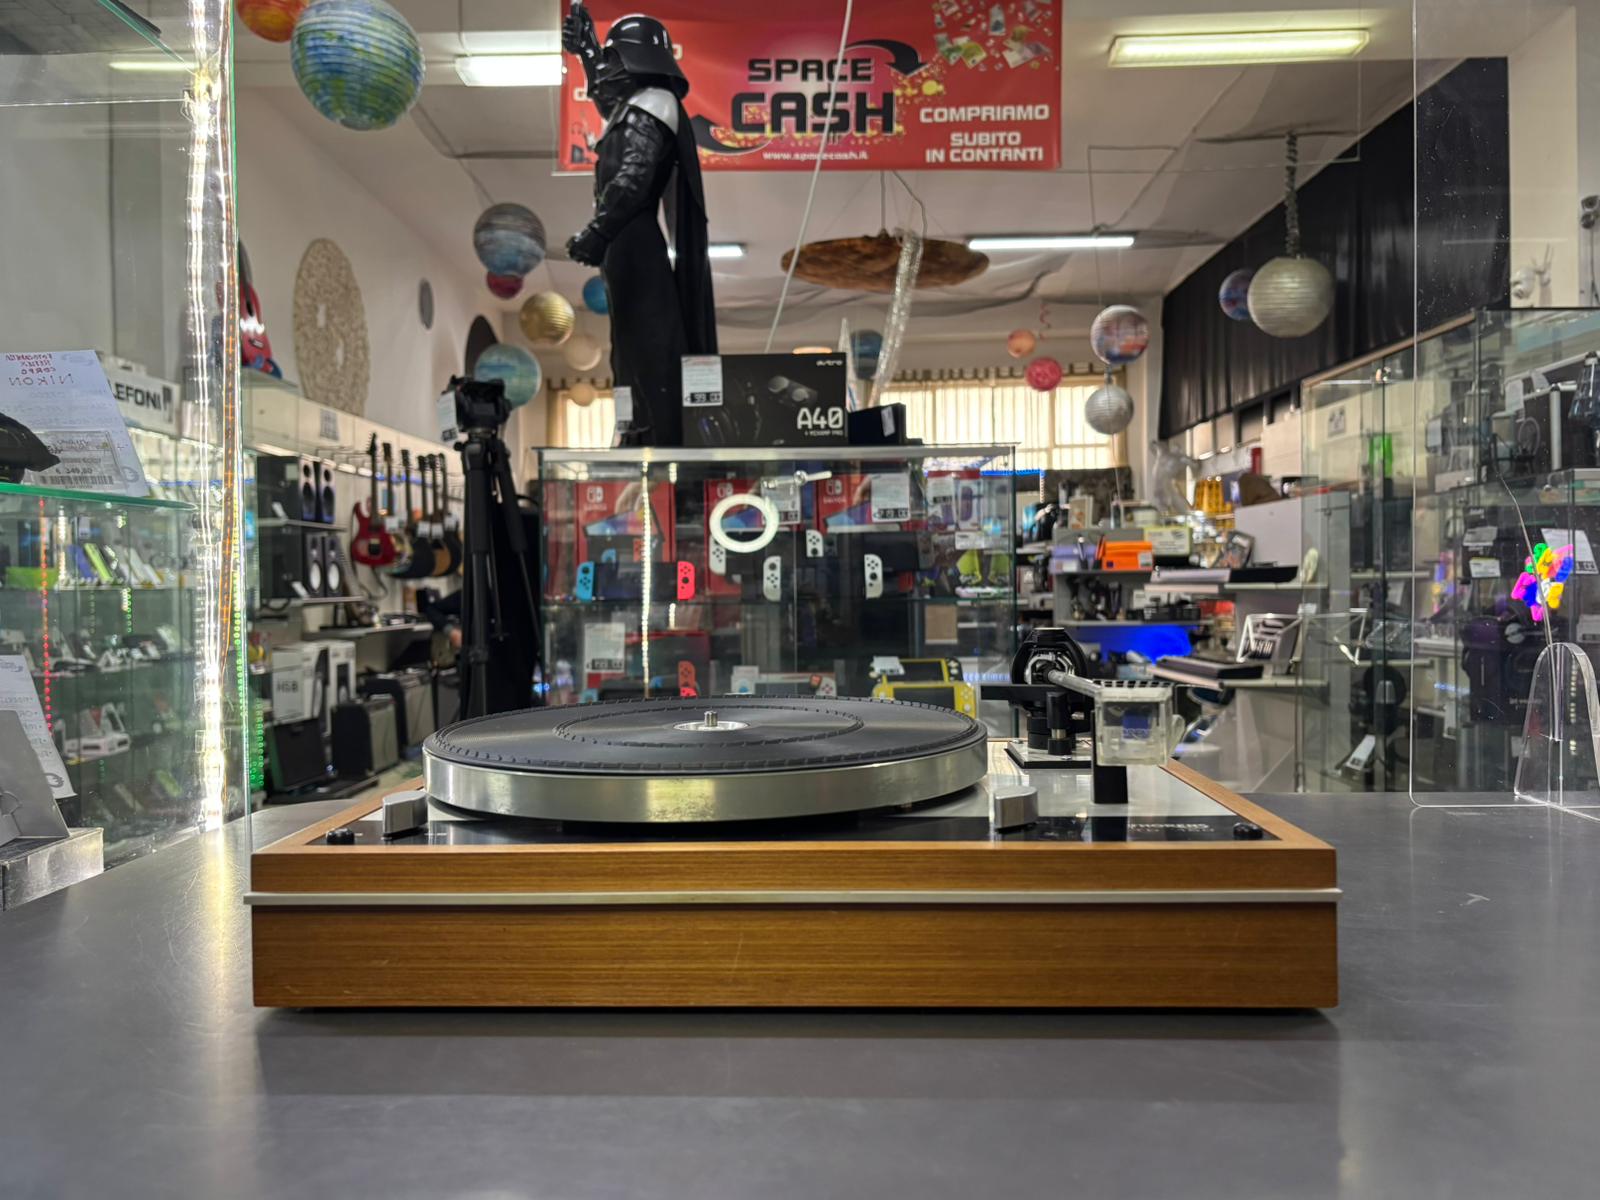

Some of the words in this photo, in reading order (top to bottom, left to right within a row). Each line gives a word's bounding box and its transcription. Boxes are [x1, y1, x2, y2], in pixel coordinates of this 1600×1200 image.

[747, 58, 872, 82] SPACE
[731, 92, 895, 134] CASH
[919, 104, 1050, 123] COMPRIAMO
[950, 131, 1021, 147] SUBITO
[925, 148, 945, 163] IN
[949, 146, 1044, 163] CONTANTI
[796, 406, 844, 429] A40
